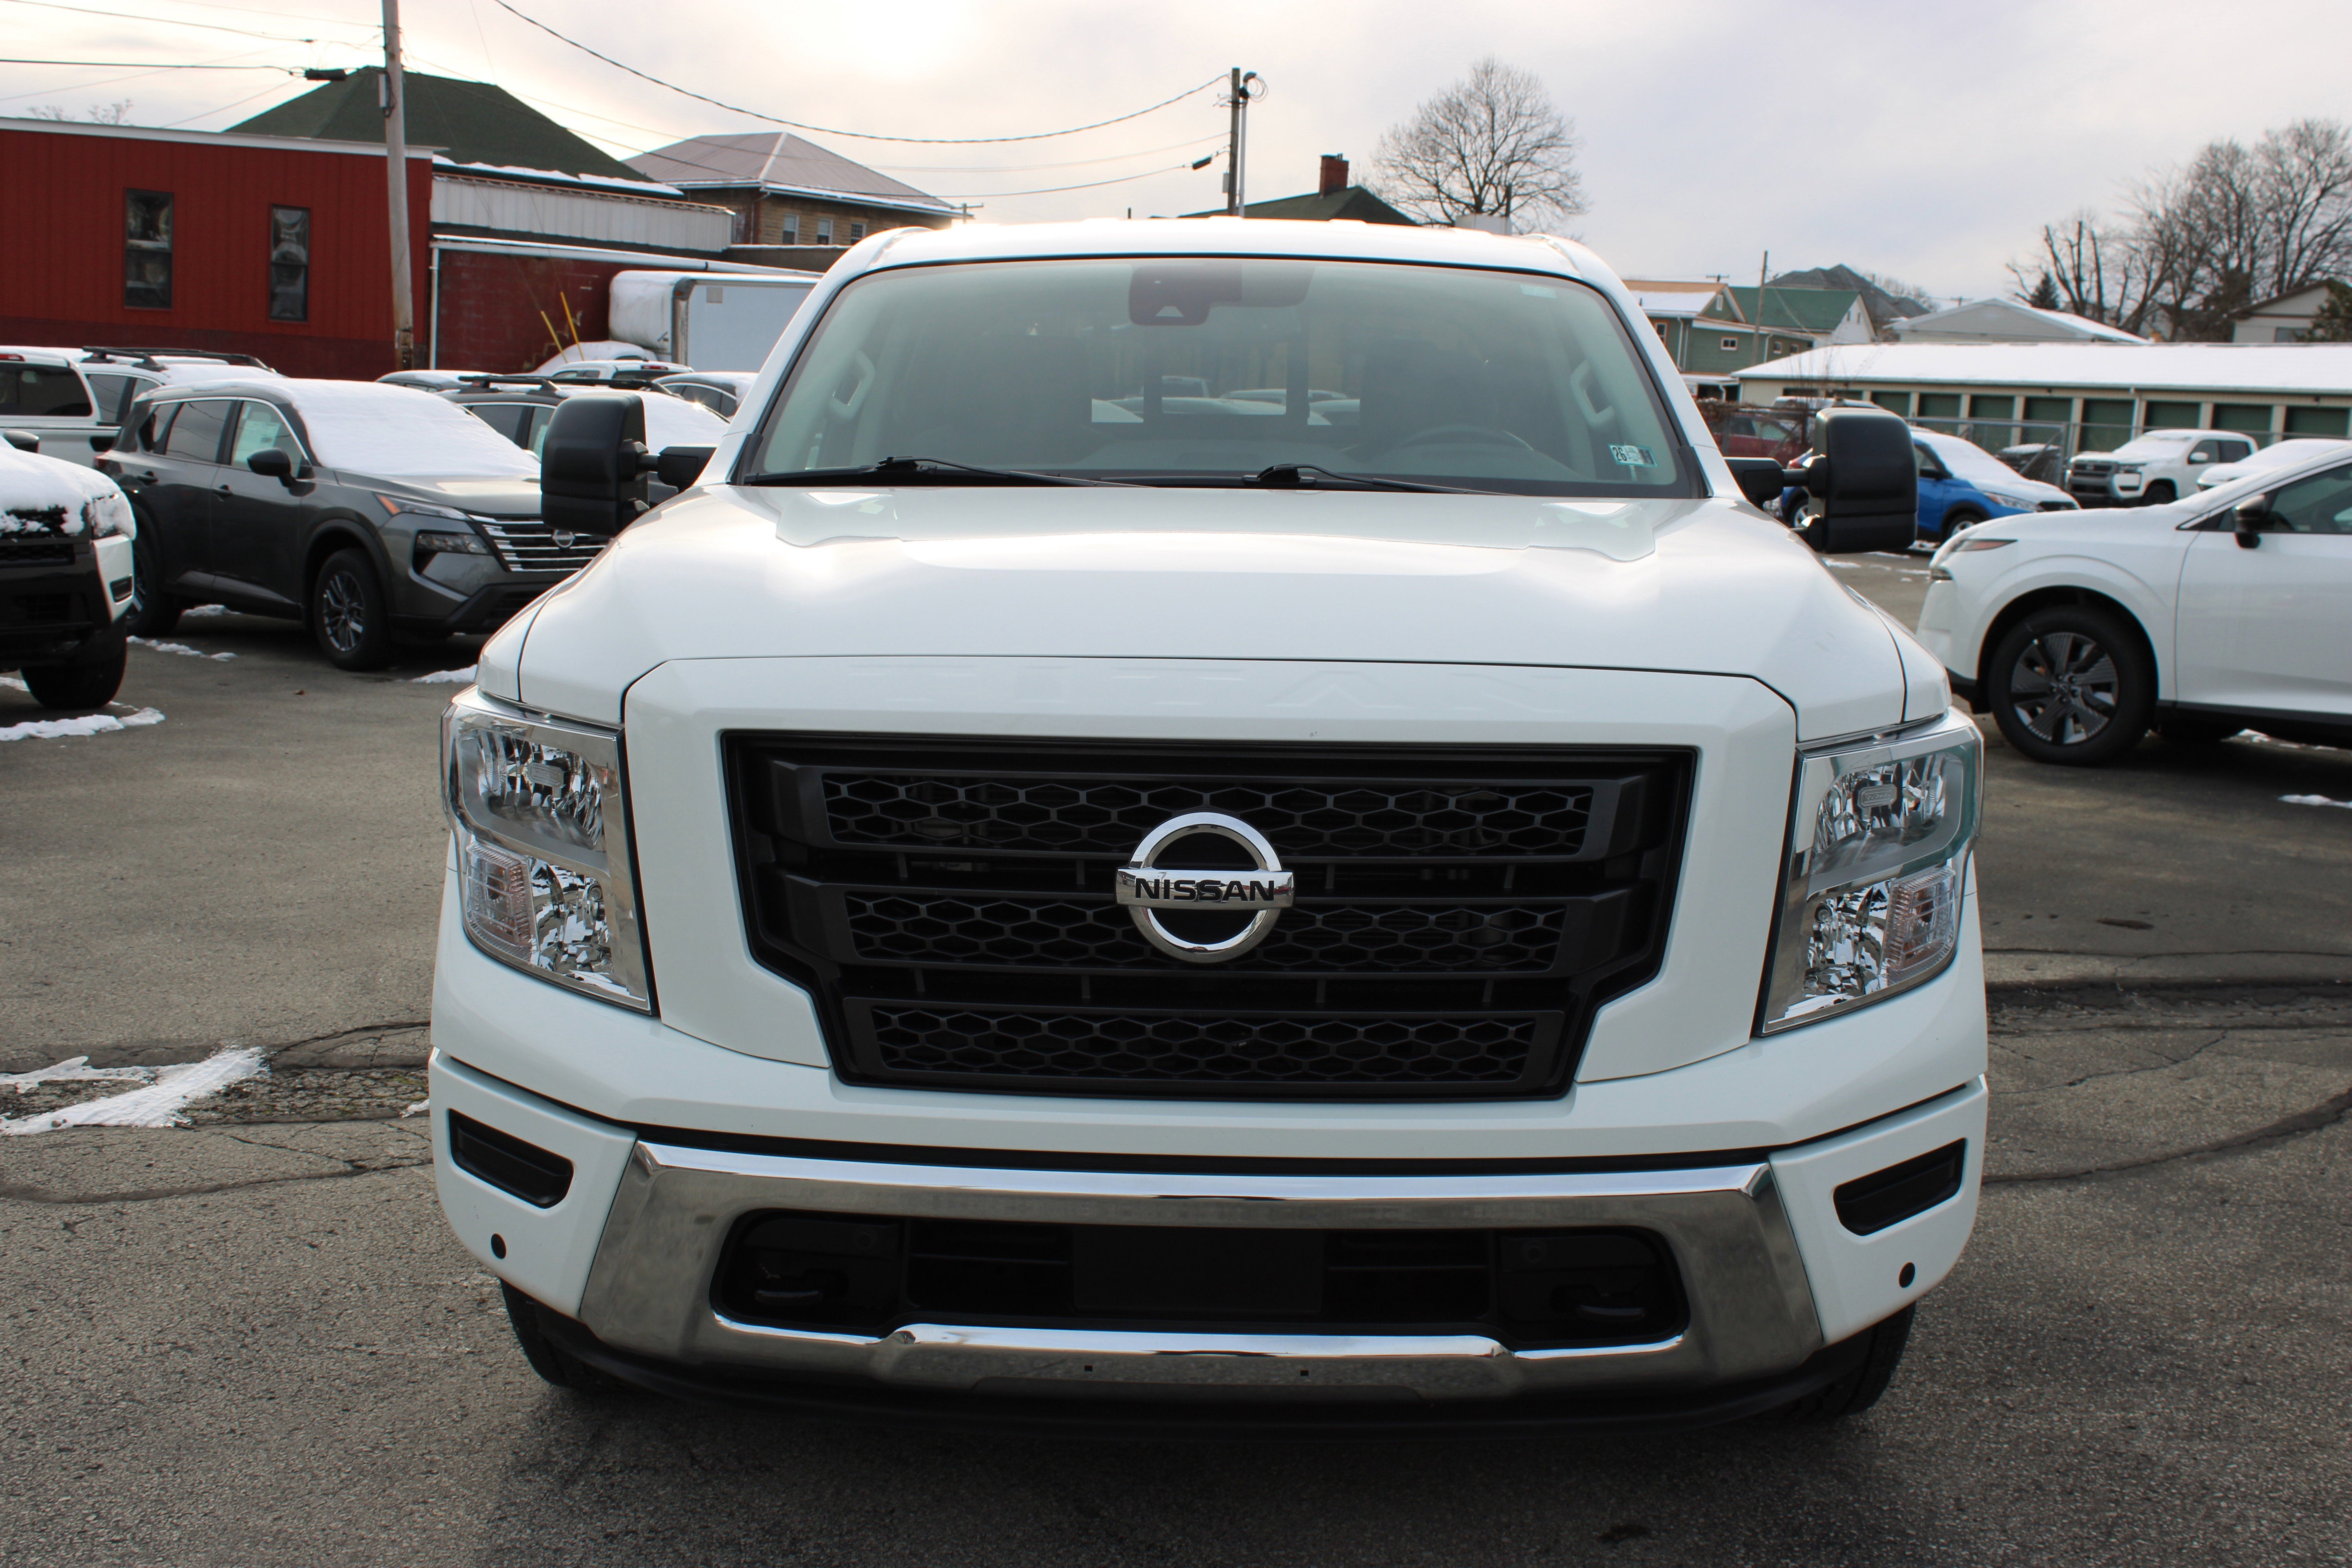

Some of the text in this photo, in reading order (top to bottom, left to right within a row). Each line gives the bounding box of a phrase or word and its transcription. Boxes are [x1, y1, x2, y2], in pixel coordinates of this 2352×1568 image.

[1612, 447, 1627, 461] 26
[1638, 449, 1654, 465] 11
[1135, 878, 1274, 902] NISSAN
